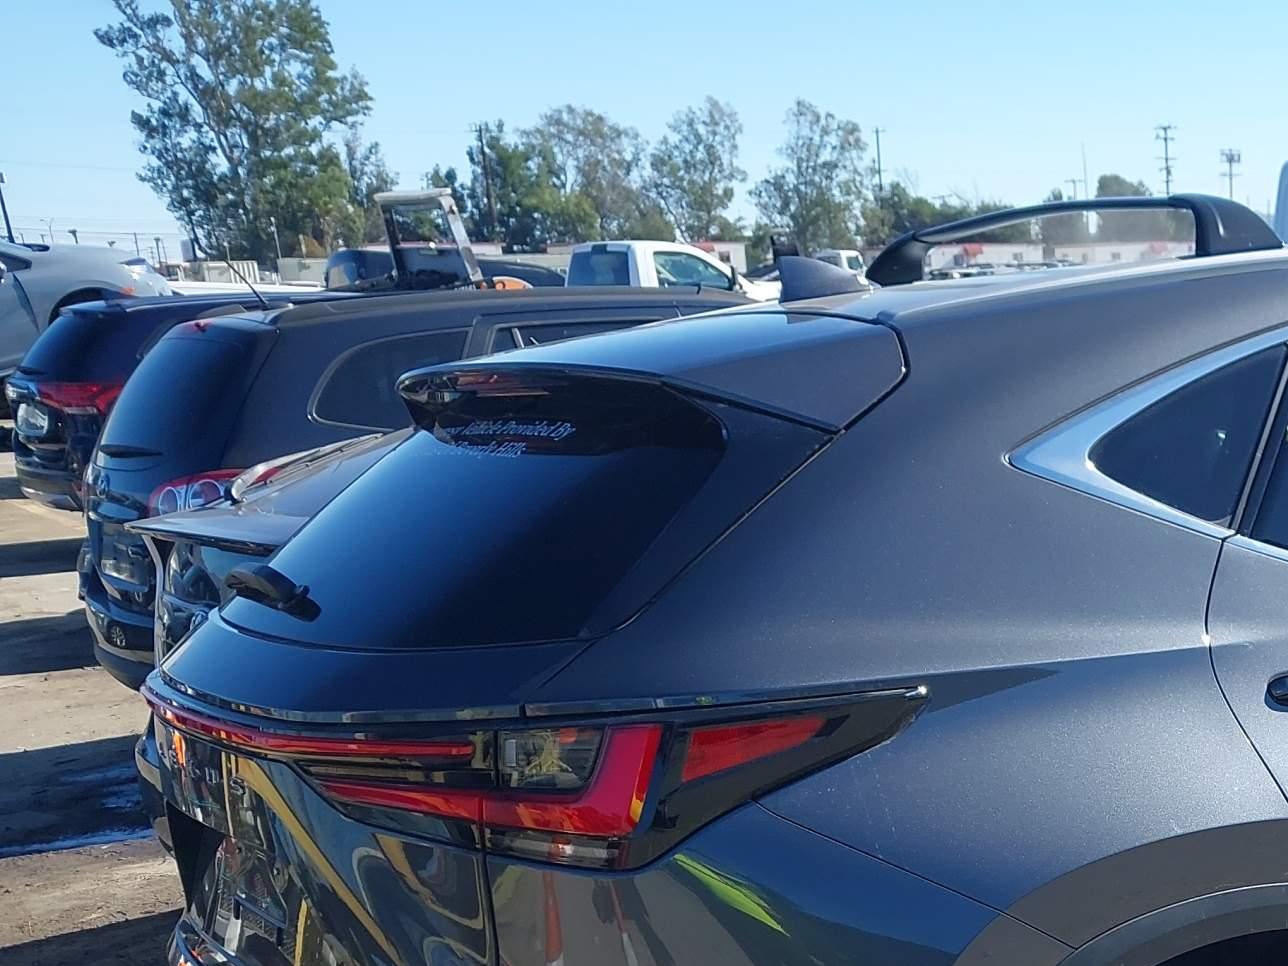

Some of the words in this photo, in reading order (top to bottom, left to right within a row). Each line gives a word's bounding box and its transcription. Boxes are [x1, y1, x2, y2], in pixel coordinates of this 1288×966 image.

[500, 420, 561, 437] Provided
[549, 422, 577, 441] By
[491, 441, 527, 458] Hills
